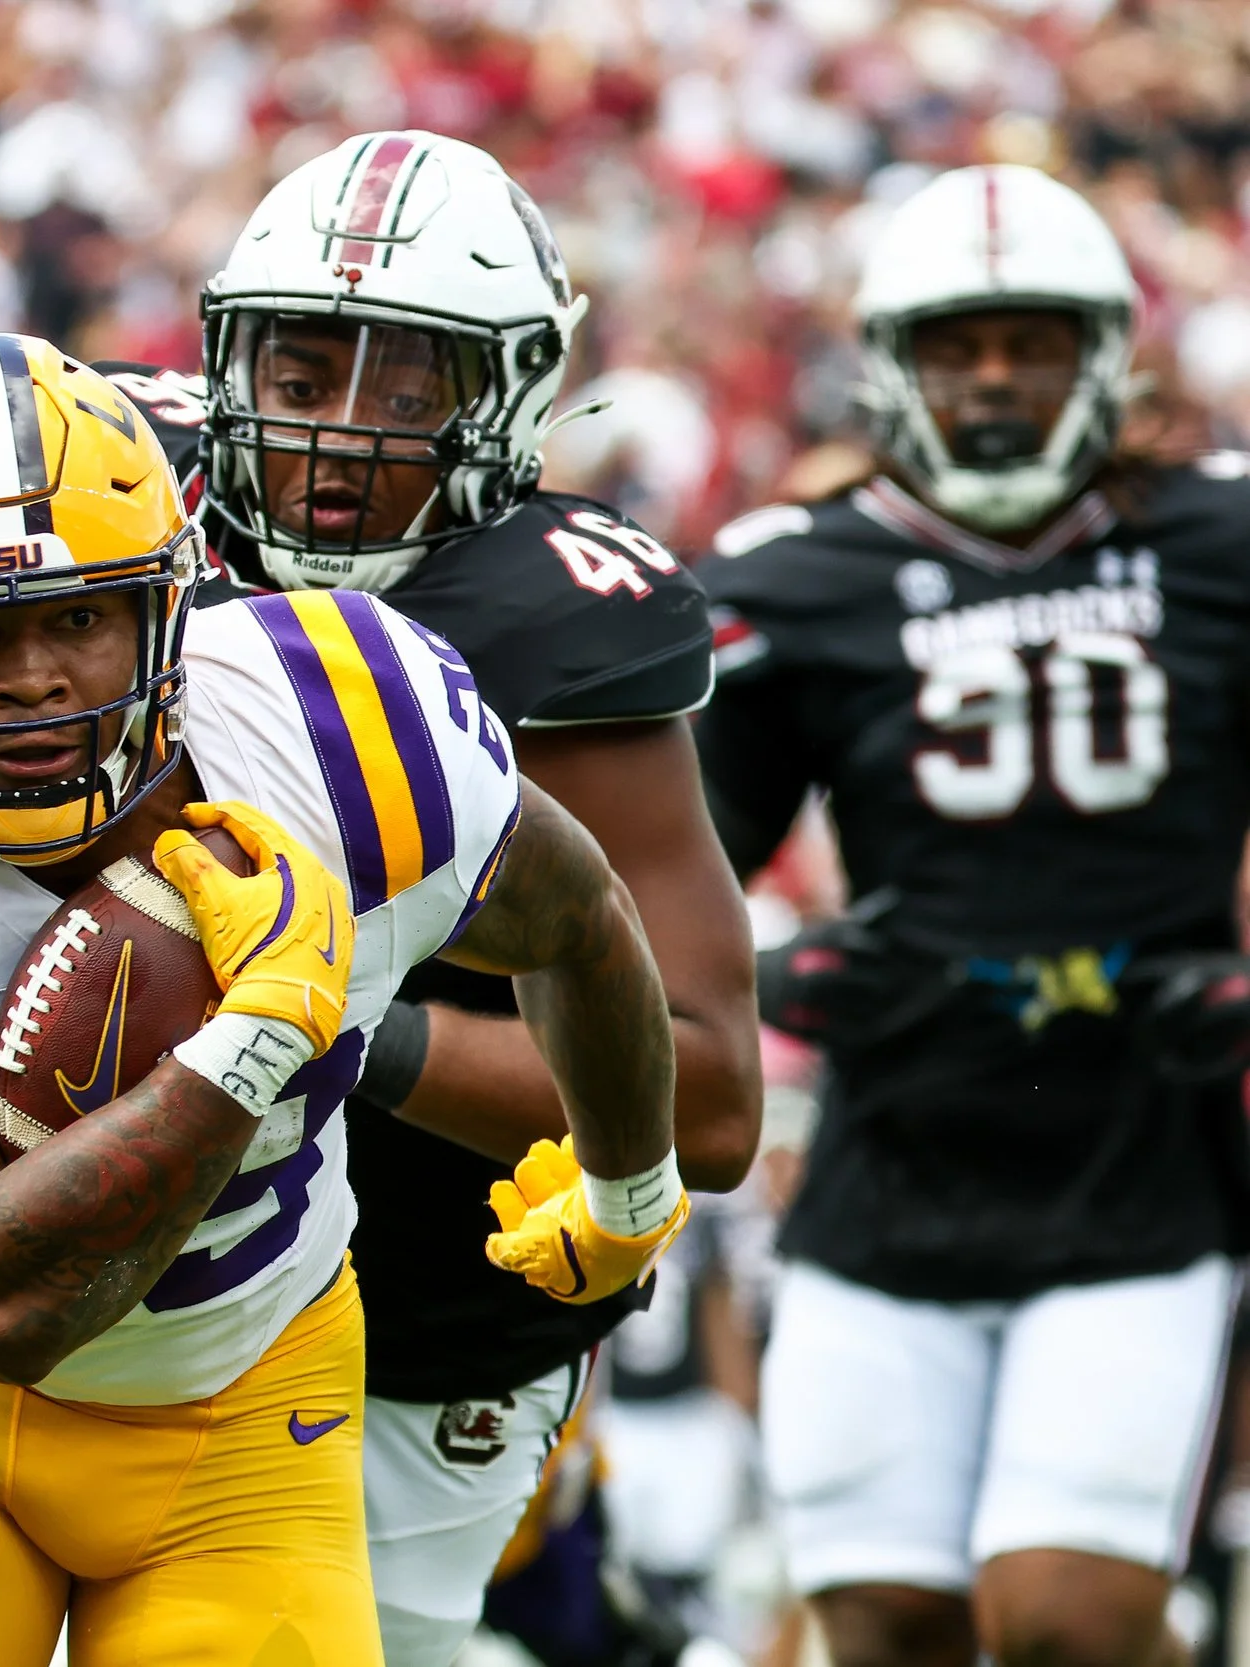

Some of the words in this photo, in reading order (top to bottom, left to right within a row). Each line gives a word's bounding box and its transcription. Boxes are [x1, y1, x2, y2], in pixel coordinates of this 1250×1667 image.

[293, 549, 354, 574] Riddell
[543, 509, 680, 601] 46
[912, 632, 1169, 820] 90
